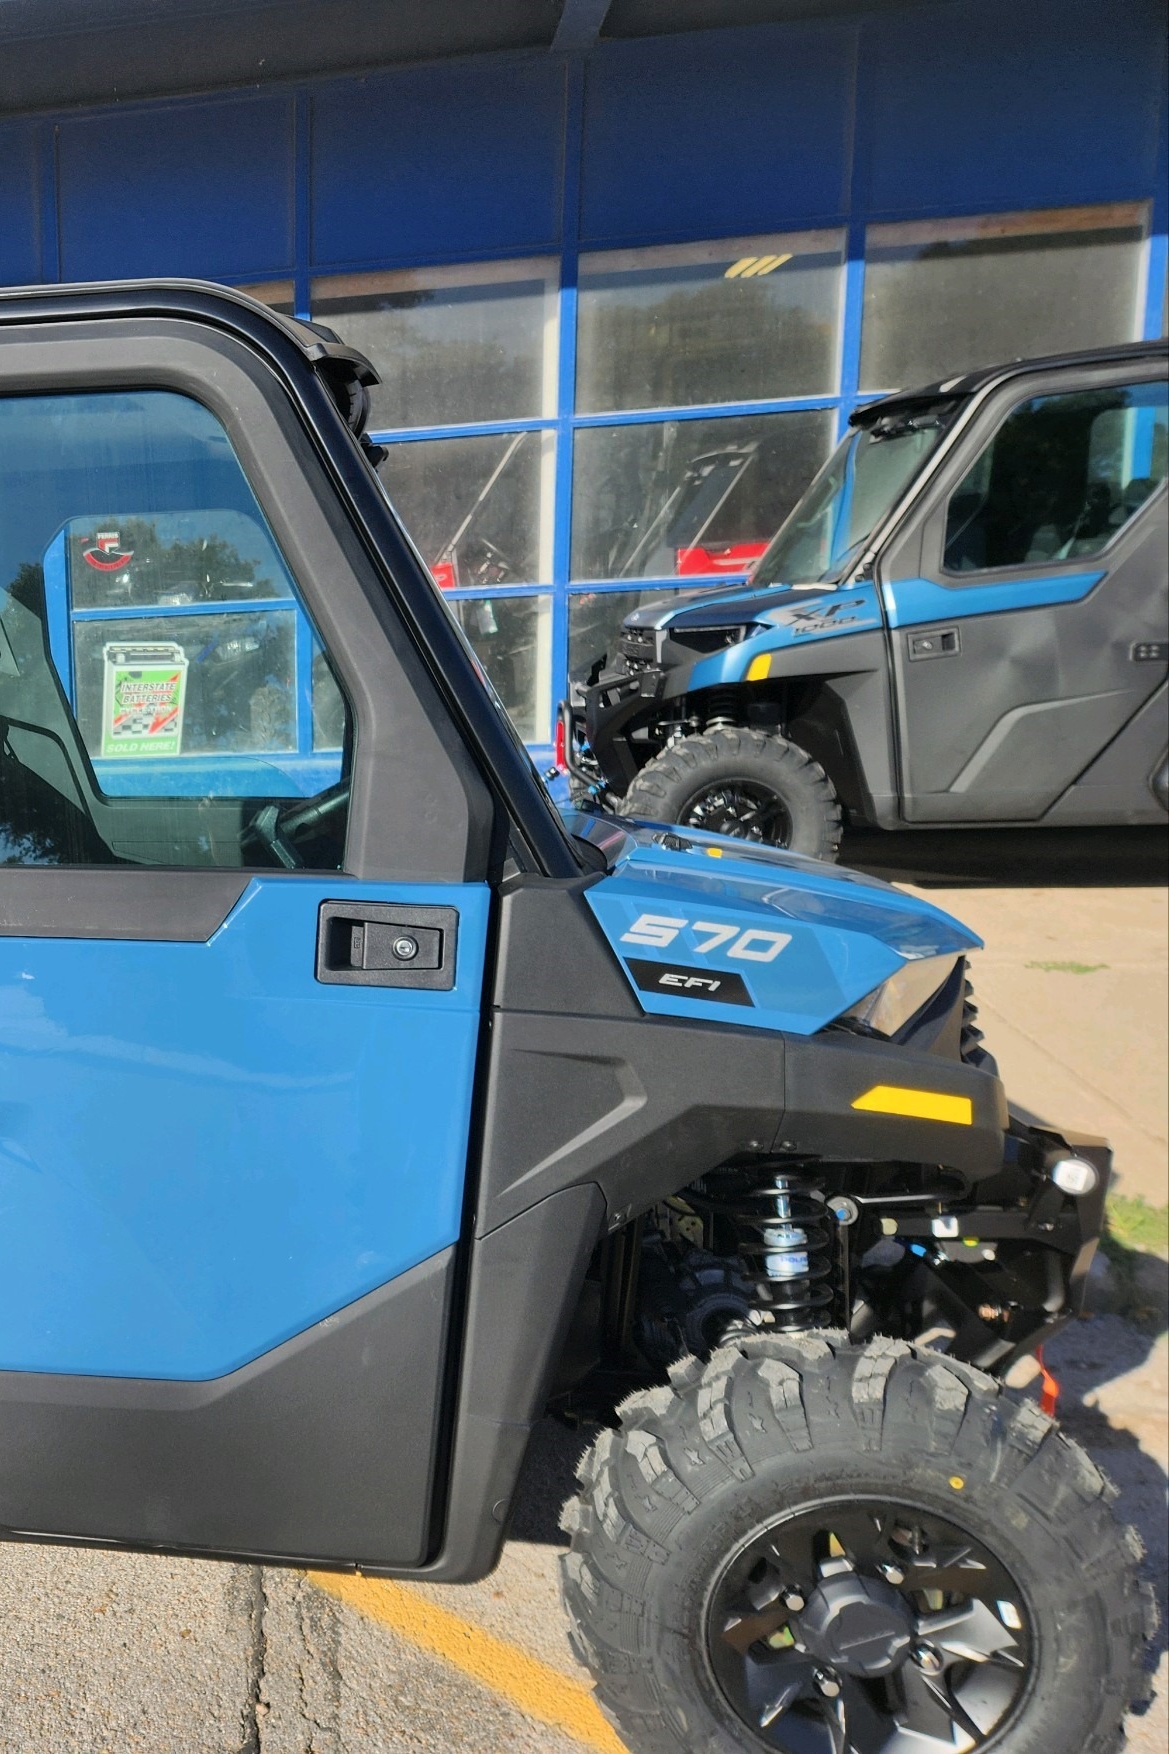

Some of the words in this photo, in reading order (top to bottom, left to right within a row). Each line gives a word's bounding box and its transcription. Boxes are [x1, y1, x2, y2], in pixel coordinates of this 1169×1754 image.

[121, 681, 177, 693] INTERSTATE
[122, 694, 172, 705] BATTERIES
[107, 743, 138, 753] SOLD
[140, 741, 176, 751] HERE!
[620, 914, 793, 963] 570
[658, 973, 721, 992] EFI
